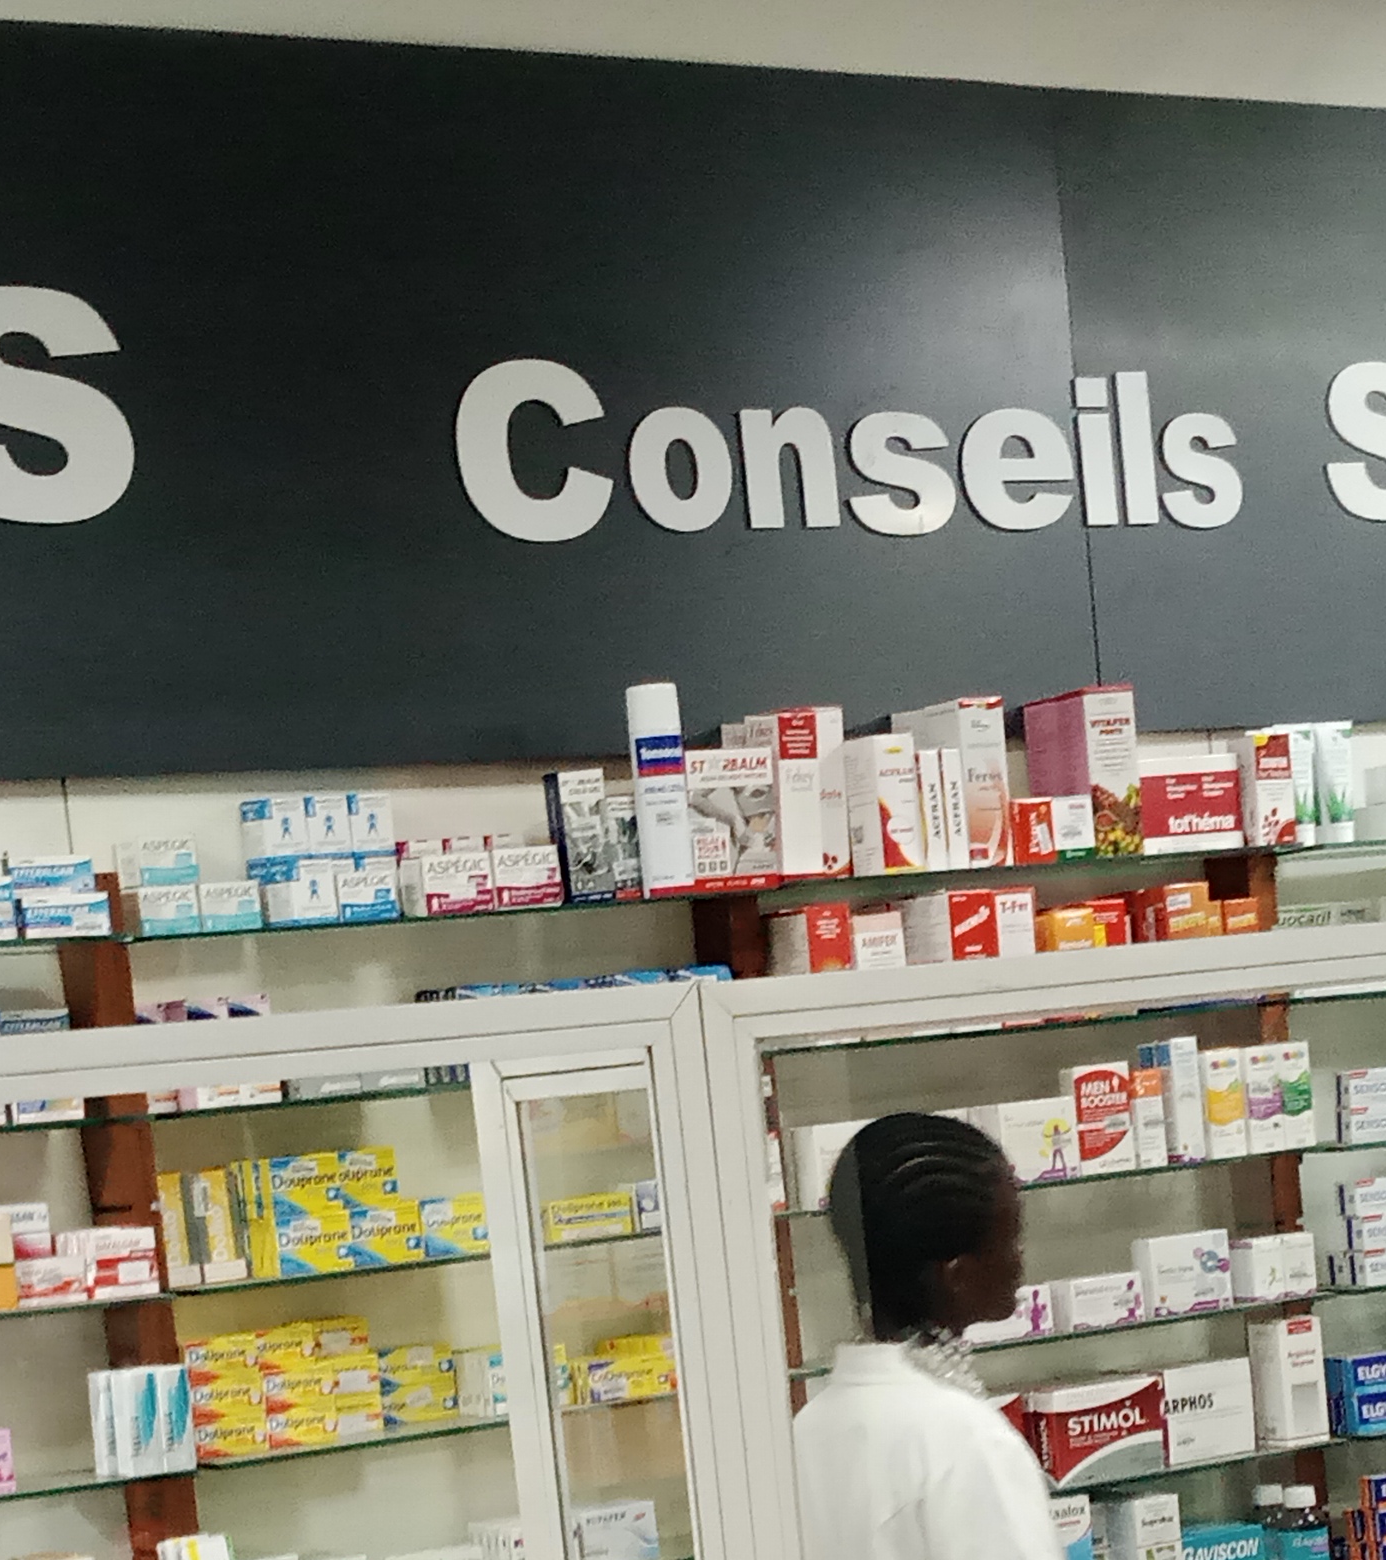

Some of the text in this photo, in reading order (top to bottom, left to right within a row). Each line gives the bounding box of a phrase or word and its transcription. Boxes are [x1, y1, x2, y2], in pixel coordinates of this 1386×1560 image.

[454, 358, 1242, 544] Conseils
[1277, 911, 1330, 927] uocaril
[1080, 1079, 1110, 1095] MEN
[340, 1164, 394, 1183] oliprane
[1068, 1403, 1147, 1436] STIMOL
